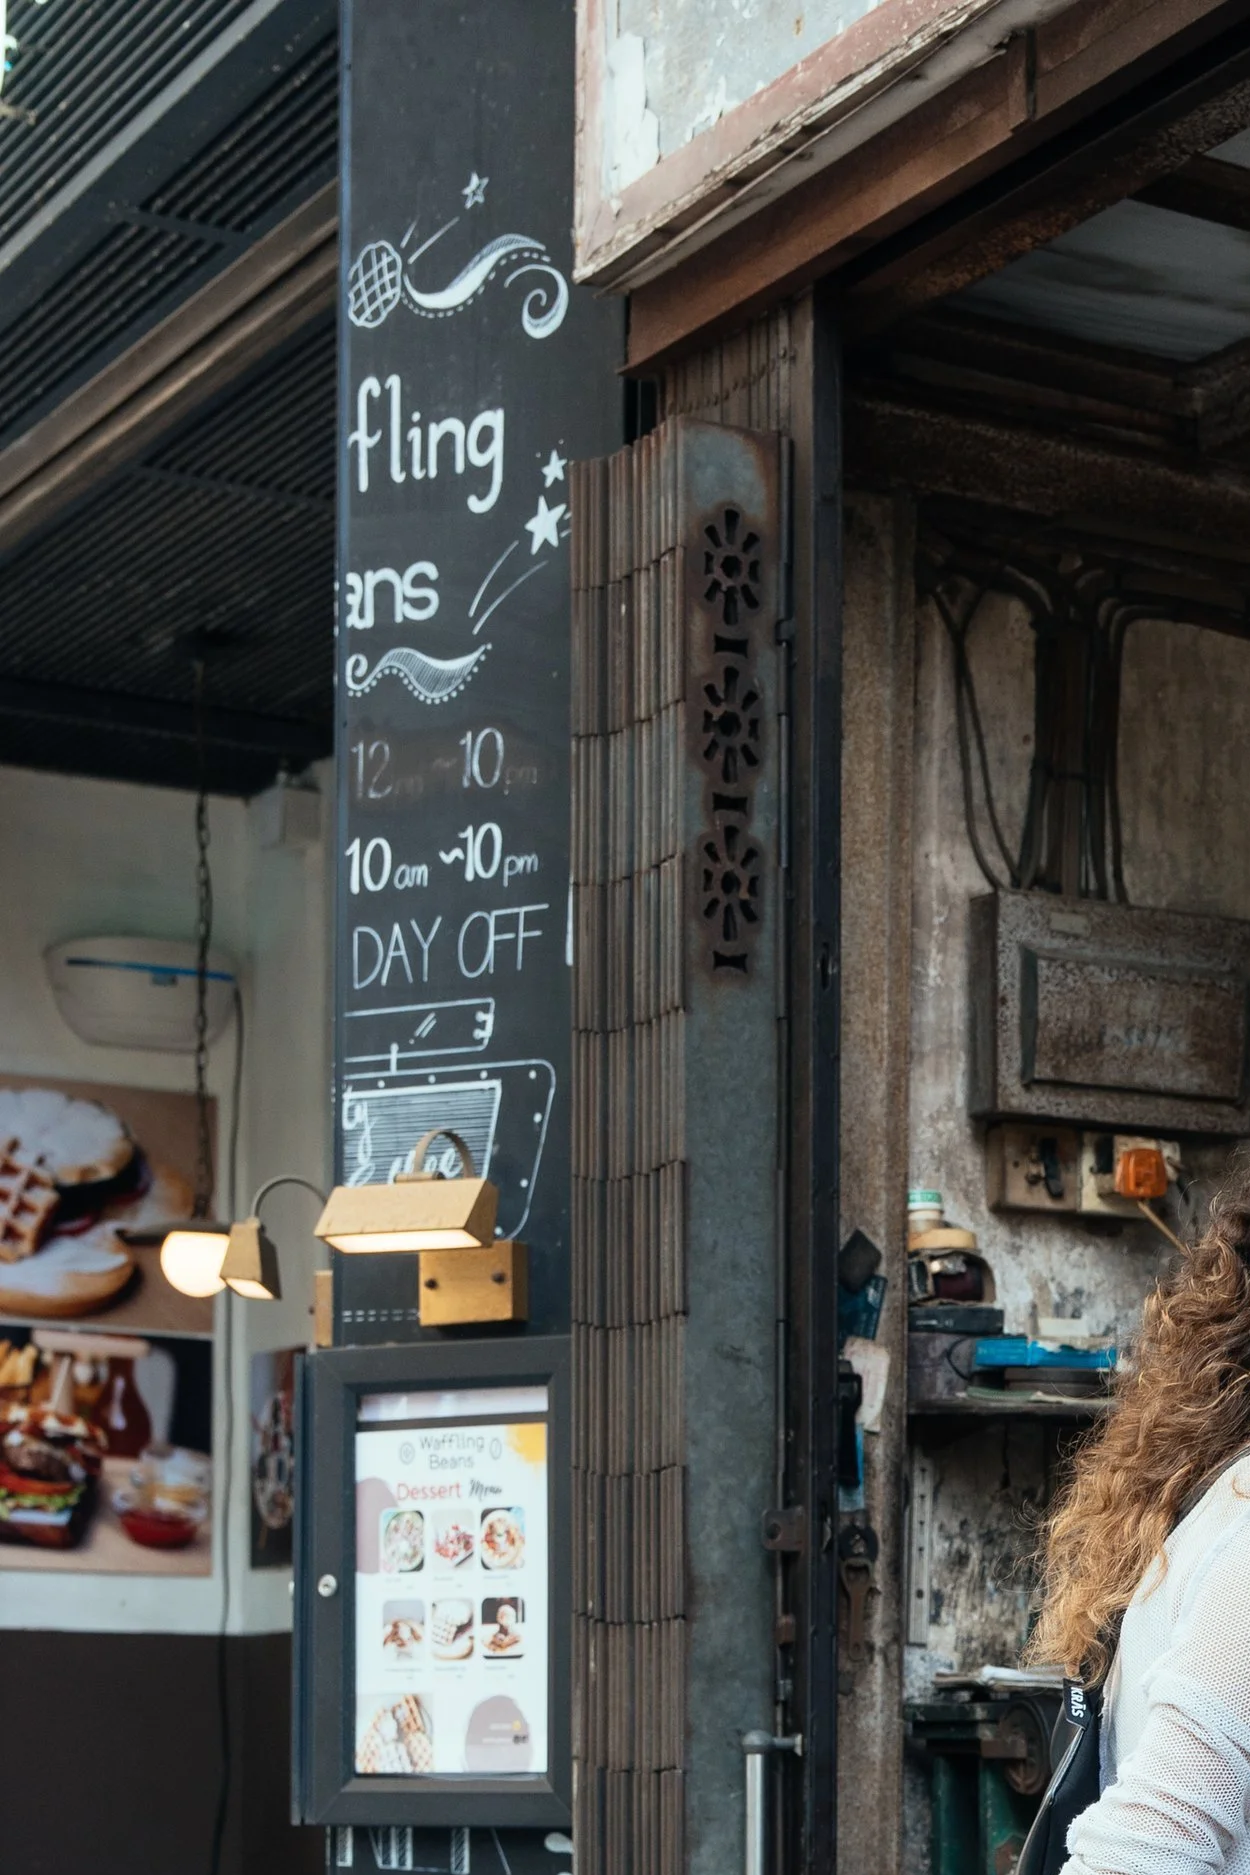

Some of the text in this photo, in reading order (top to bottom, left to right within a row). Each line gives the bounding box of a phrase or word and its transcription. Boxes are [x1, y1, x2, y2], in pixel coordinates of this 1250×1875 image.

[352, 902, 550, 990] DAY OFF
[420, 1434, 485, 1453] Waffling
[429, 1453, 475, 1470] Beans
[397, 1482, 462, 1500] Dessert
